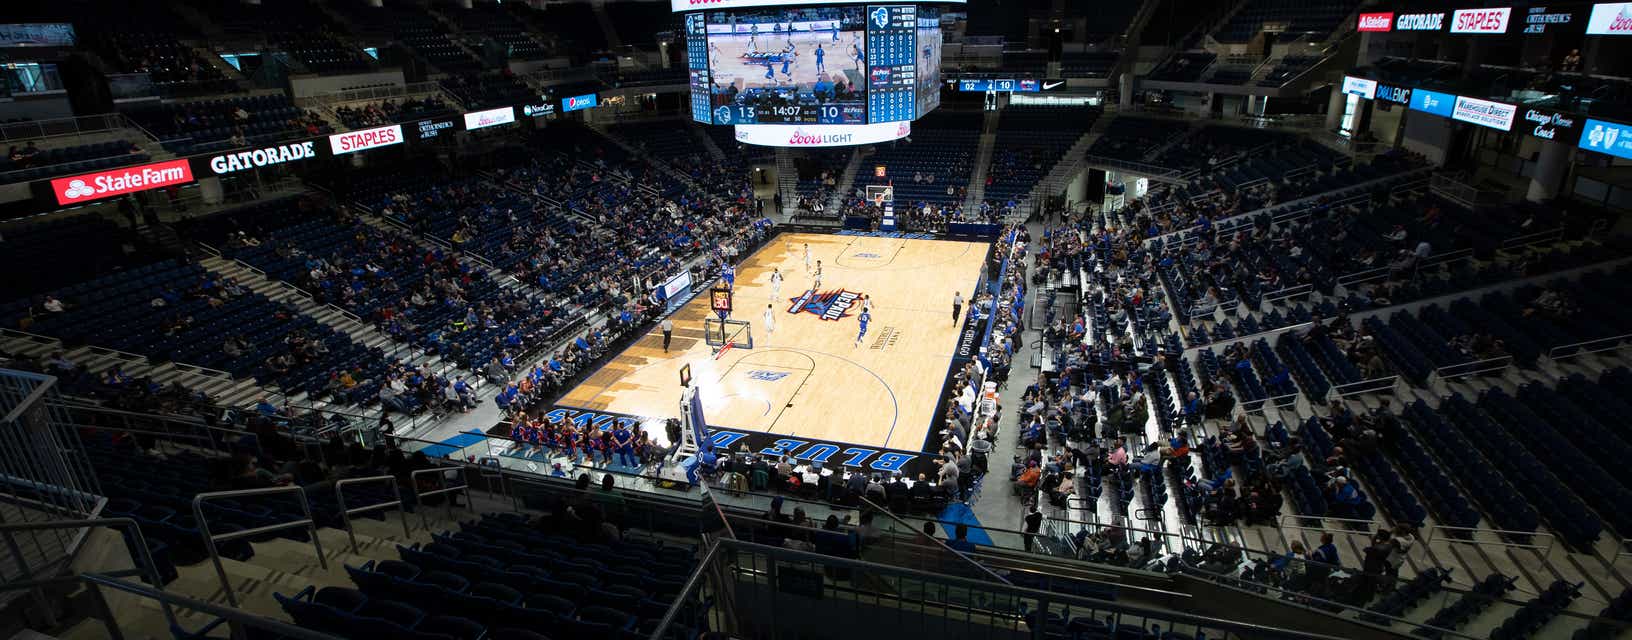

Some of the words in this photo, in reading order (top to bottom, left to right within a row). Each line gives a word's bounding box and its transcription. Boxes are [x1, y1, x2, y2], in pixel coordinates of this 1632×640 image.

[1396, 13, 1444, 30] GATORADE
[1457, 11, 1500, 30] STAPLES
[1610, 12, 1632, 30] Coo
[1392, 88, 1410, 103] EMC
[738, 107, 755, 118] 13
[772, 106, 800, 115] 14:07
[821, 107, 838, 118] 10
[1488, 105, 1510, 118] DIRECT
[1525, 110, 1551, 124] Chicago
[340, 129, 396, 151] STAPLES
[789, 130, 822, 145] Coors
[824, 133, 853, 143] LIGHT
[1534, 126, 1555, 140] Coach
[210, 142, 315, 174] GATORADE
[94, 166, 184, 194] StateFarm
[960, 330, 976, 356] CHICAGO
[759, 438, 918, 472] BLUE
